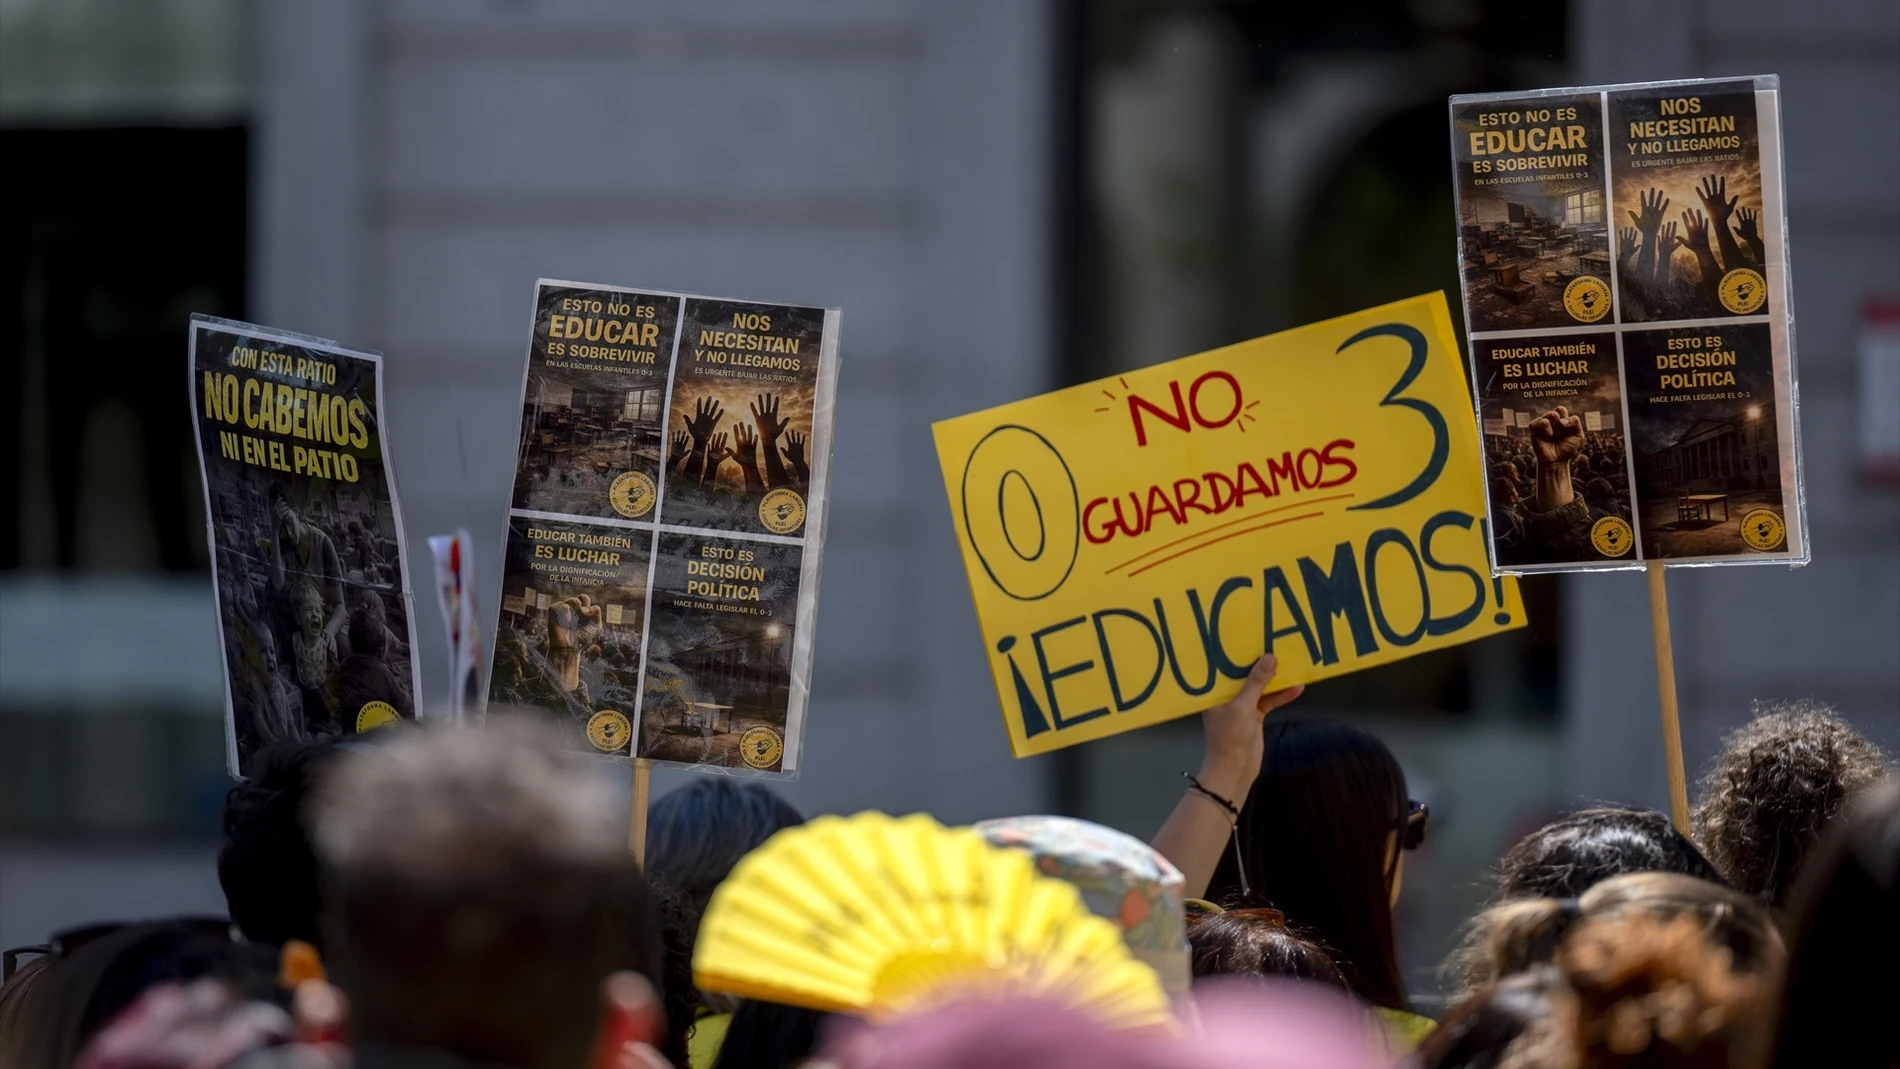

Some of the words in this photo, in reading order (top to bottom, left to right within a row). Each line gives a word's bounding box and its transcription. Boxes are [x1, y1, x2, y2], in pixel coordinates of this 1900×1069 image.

[1661, 97, 1701, 115] NOS
[1479, 112, 1519, 126] ESTO
[1526, 110, 1550, 123] NO
[1556, 108, 1576, 120] ES
[1630, 115, 1735, 138] NECESITAN
[1470, 125, 1587, 155] EDUCAR
[1627, 143, 1637, 155] Y
[1641, 141, 1662, 154] NO
[1667, 136, 1740, 153] LLEGAMOS
[1473, 160, 1491, 173] ES
[1496, 154, 1588, 172] SOBREVIVIR
[1642, 158, 1674, 167] URGENTE
[1500, 176, 1534, 184] ESCUELAS
[1536, 173, 1574, 181] INFANTILES
[563, 298, 602, 313] ESTO
[608, 303, 630, 316] NO
[636, 306, 655, 318] ES
[549, 314, 659, 347] EDUCAR
[733, 313, 771, 331] NOS
[700, 330, 800, 354] NECESITAN
[1492, 347, 1540, 359] EDUCAR
[1542, 342, 1595, 356] TAMBIÉN
[1668, 337, 1701, 350] ESTO
[1705, 336, 1722, 347] ES
[548, 342, 565, 355] ES
[570, 345, 655, 364] SOBREVIVIR
[695, 349, 704, 361] Y
[707, 351, 727, 364] NO
[731, 353, 800, 371] LLEGAMOS
[1656, 348, 1736, 369] DECISIÓN
[232, 346, 257, 369] CON
[260, 352, 293, 377] ESTA
[297, 358, 336, 385] RATIO
[571, 363, 601, 371] ESCUELAS
[604, 366, 639, 375] INFANTILES
[1504, 364, 1522, 377] ES
[1526, 360, 1588, 376] LUCHAR
[705, 368, 735, 377] URGENTE
[737, 371, 757, 379] BAJAR
[774, 375, 797, 383] RATIOS
[1503, 382, 1518, 390] POR
[1532, 378, 1587, 388] DIGNIFICACIÓN
[1661, 370, 1735, 389] POLÍTICA
[1693, 393, 1725, 401] LEGISLAR
[204, 371, 239, 424] NO
[243, 379, 368, 449] CABEMOS
[1127, 370, 1243, 447] NO
[1336, 323, 1449, 511] 3
[220, 431, 239, 461] NI
[243, 436, 266, 467] EN
[269, 441, 291, 472] EL
[294, 446, 359, 482] PATIO
[1083, 439, 1357, 544] GUARDAMOS
[528, 528, 575, 543] EDUCAR
[579, 533, 631, 549] TAMBIÉN
[535, 545, 553, 559] ES
[558, 547, 620, 566] LUCHAR
[702, 546, 733, 559] ESTO
[738, 550, 754, 561] ES
[560, 566, 615, 578] DIGNIFICACIÓN
[572, 576, 604, 585] INFANCIA
[688, 560, 764, 582] DECISIÓN
[688, 580, 759, 601] POLÍTICA
[674, 600, 692, 608] HACE
[694, 602, 714, 610] FALTA
[716, 605, 748, 613] LEGISLAR
